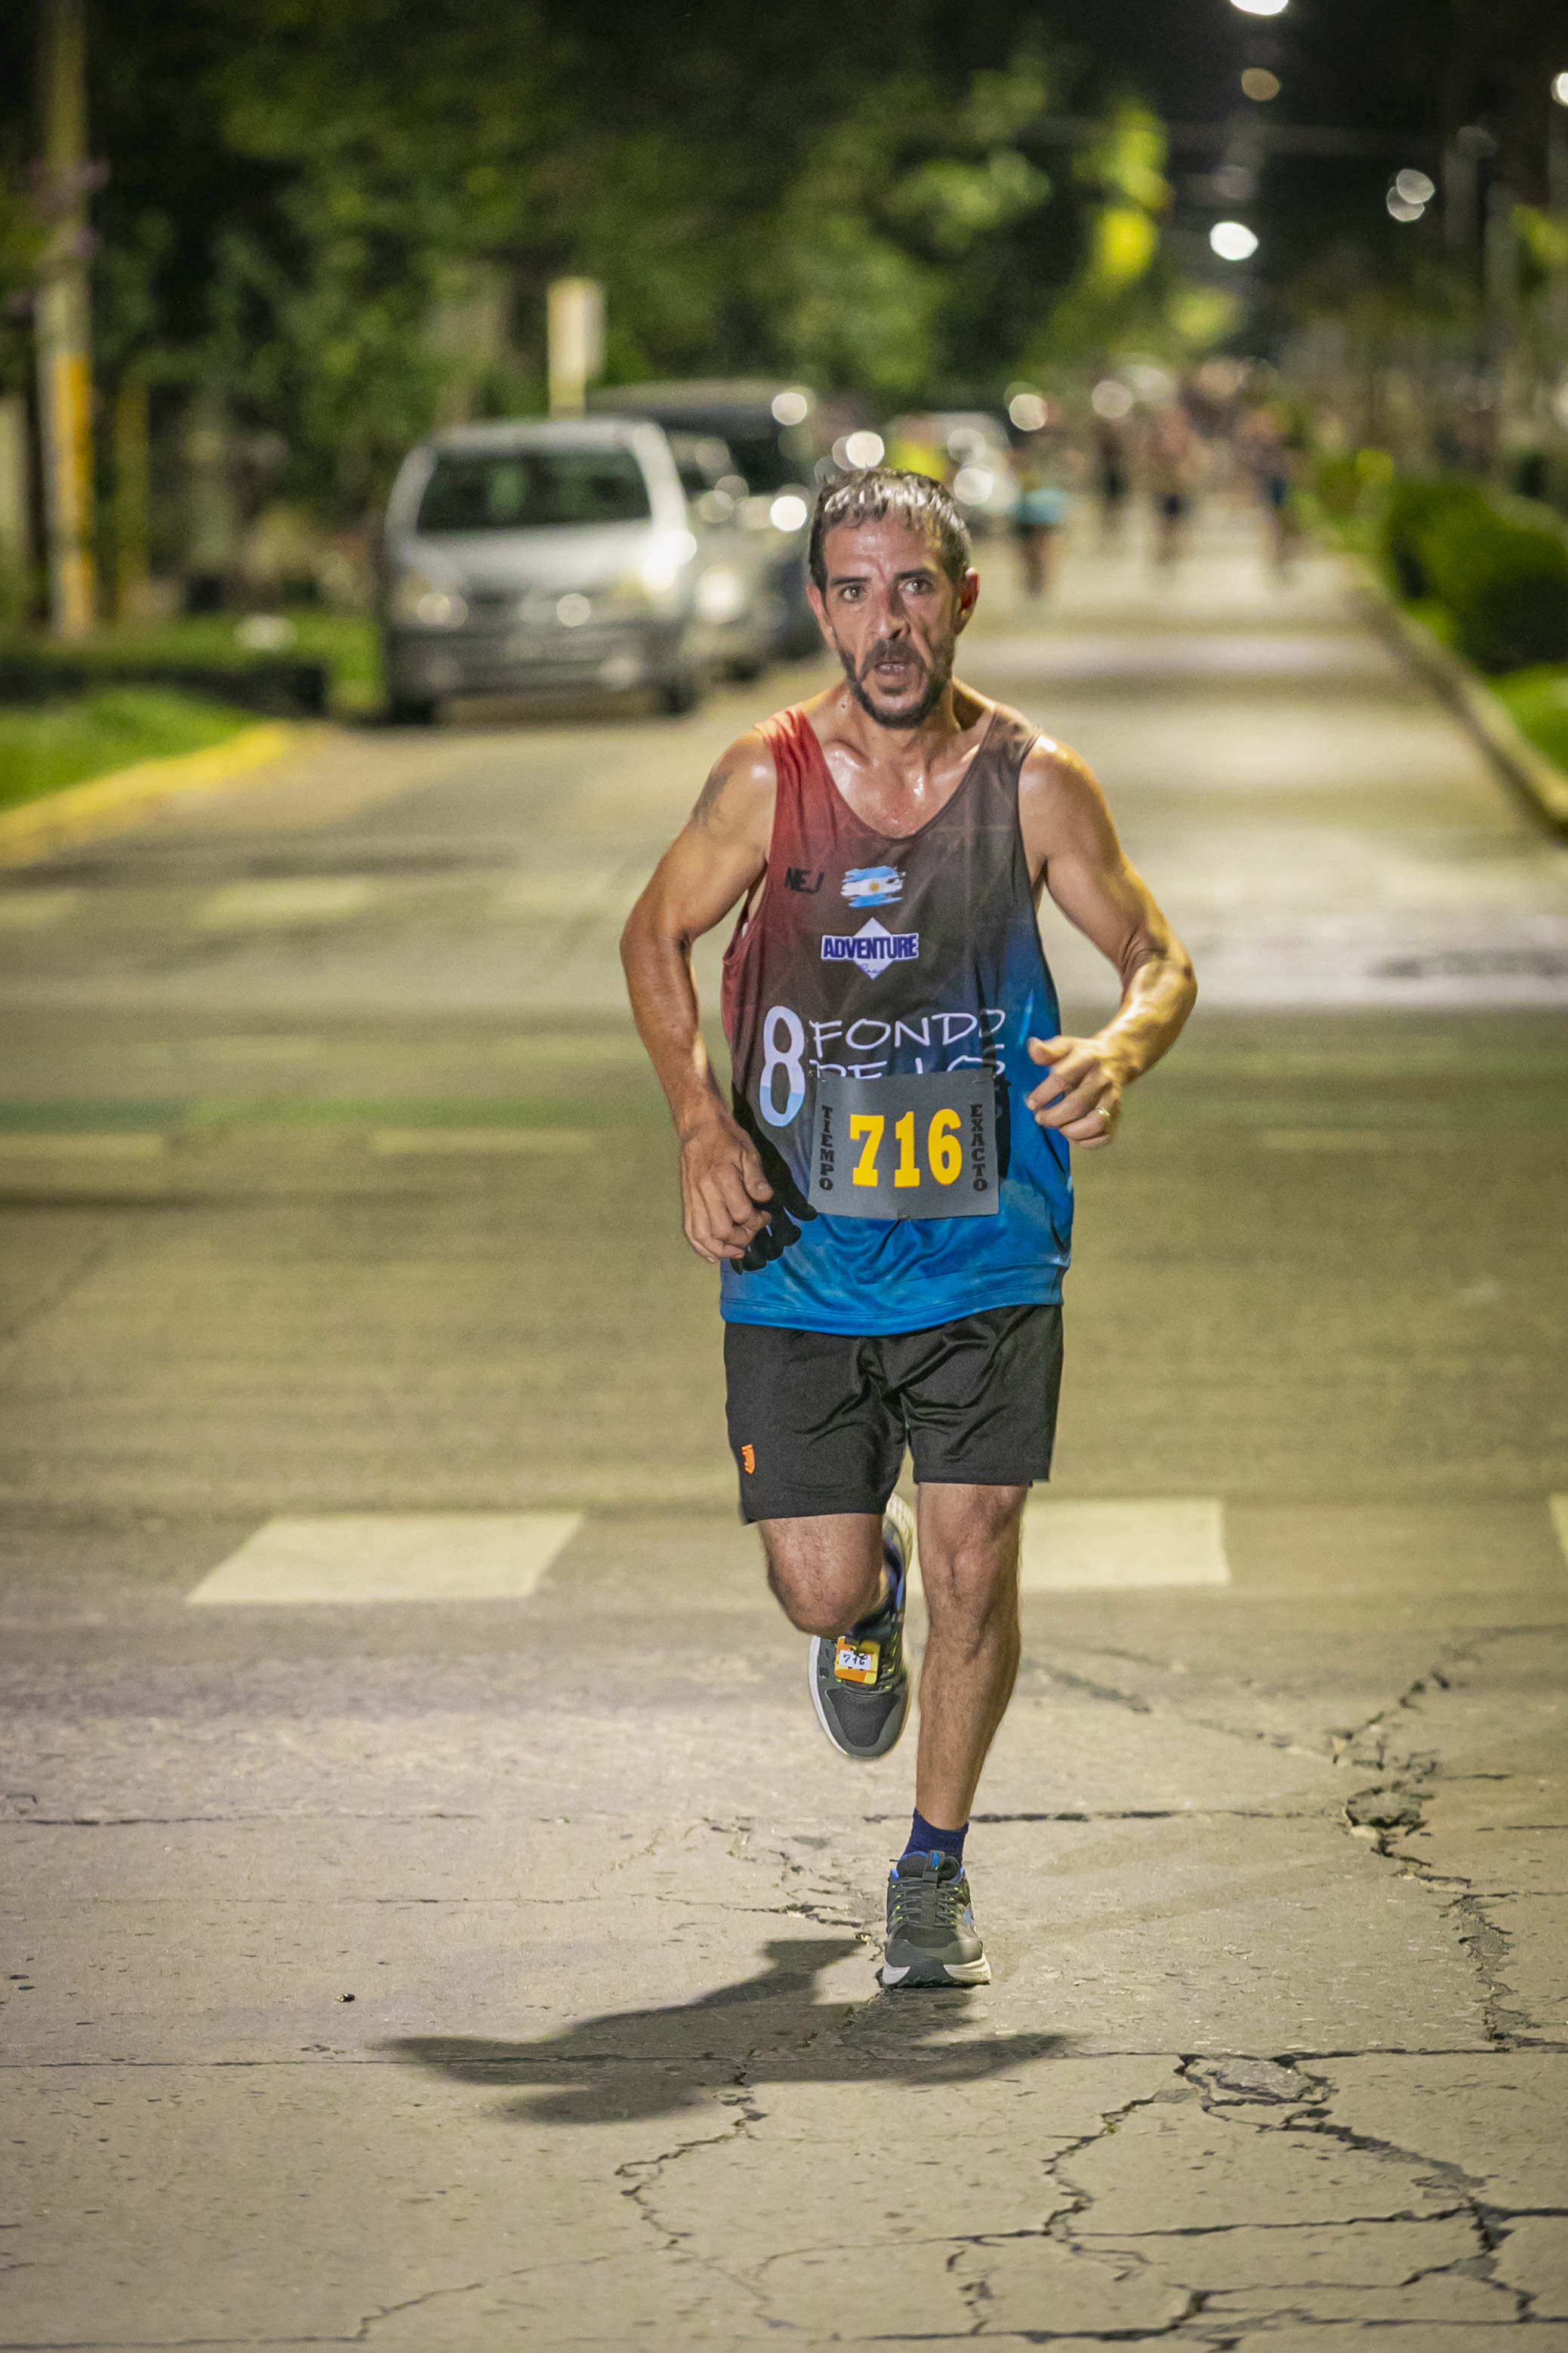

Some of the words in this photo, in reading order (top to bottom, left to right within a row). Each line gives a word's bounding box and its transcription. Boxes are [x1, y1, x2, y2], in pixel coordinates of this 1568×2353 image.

[823, 934, 917, 959] ADVENTURE
[819, 1104, 834, 1191] TIEMPO
[849, 1108, 963, 1188] 716
[970, 1104, 987, 1192] EXACTO
